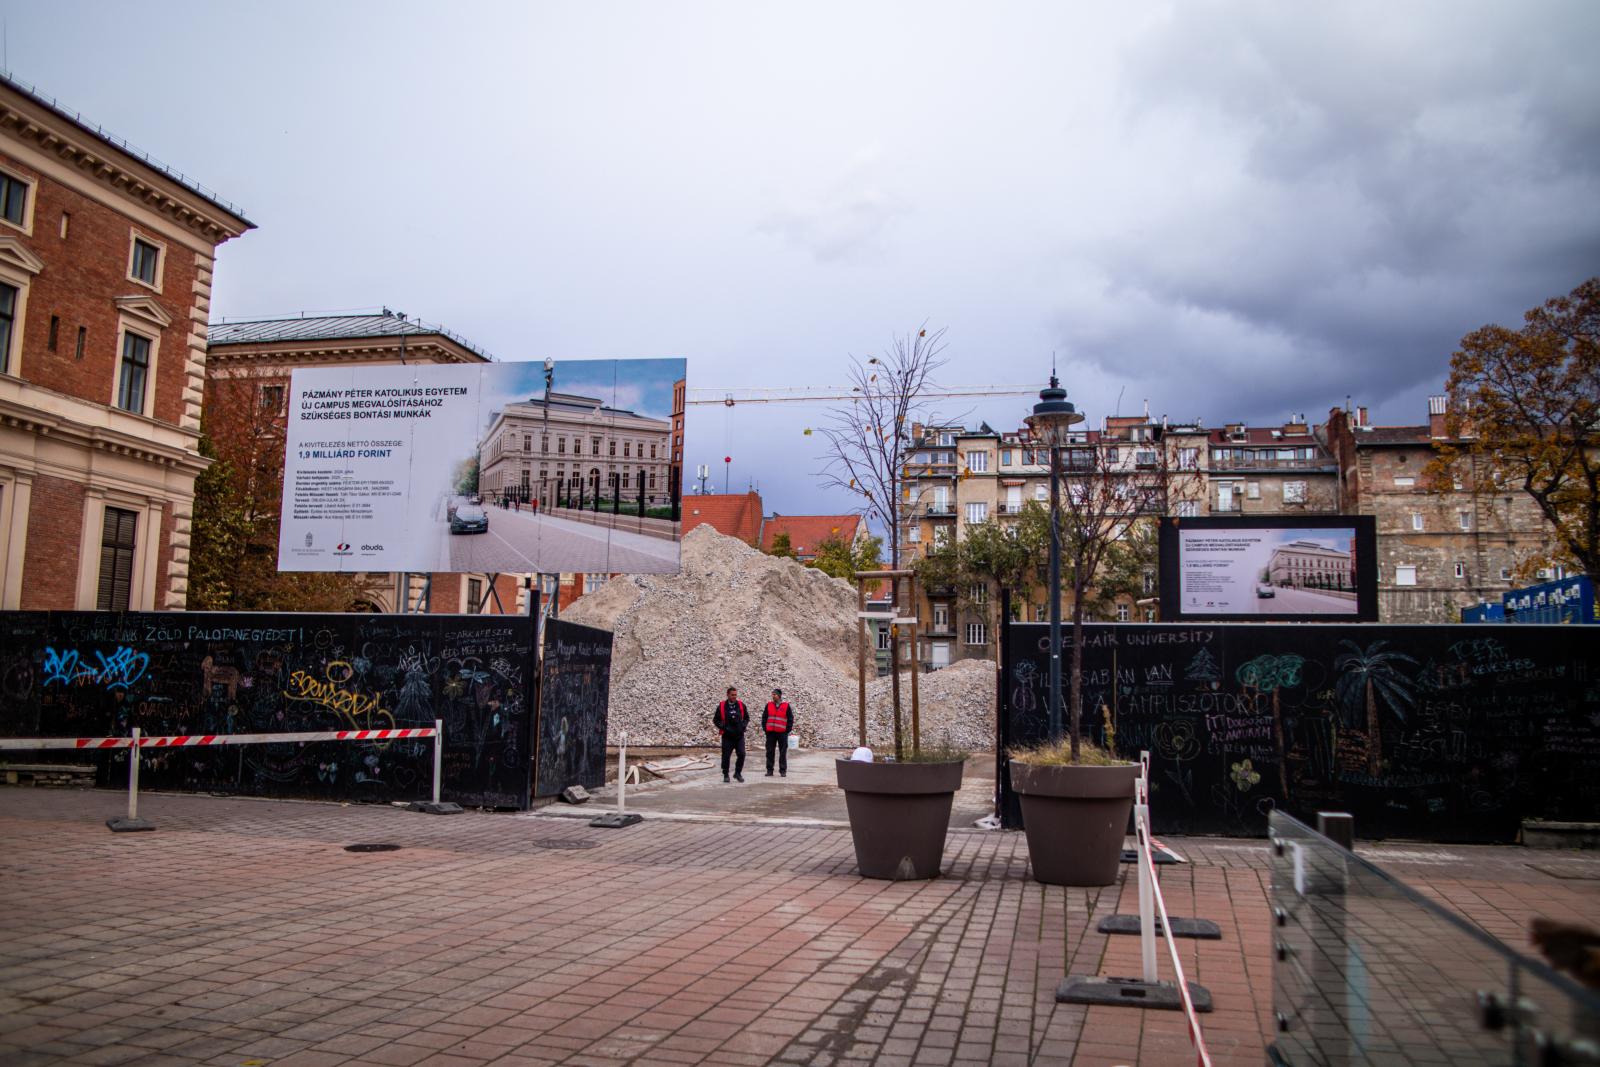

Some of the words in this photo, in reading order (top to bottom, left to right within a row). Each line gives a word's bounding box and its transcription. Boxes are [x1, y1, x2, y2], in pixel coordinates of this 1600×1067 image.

[302, 389, 343, 399] PÁZMÁNY
[345, 388, 373, 398] PÉTER
[374, 388, 423, 398] KATOLIKUS
[425, 387, 468, 396] EGYETEM
[301, 401, 312, 410] ÚJ
[314, 401, 350, 409] CAMPUS
[351, 398, 443, 408] MEGVALÓSÍTÁSÁHOZ
[300, 411, 351, 420] SZÜKSÉGES
[353, 410, 391, 419] BONTÁSI
[393, 409, 431, 418] MUNKÁK
[304, 440, 346, 448] KIVITELEZÉS
[298, 450, 311, 459] 1,9
[312, 449, 356, 459] MILLIÁRD
[357, 449, 392, 458] FORINT
[145, 626, 182, 642] ZÖLD
[1144, 662, 1173, 681] VAN
